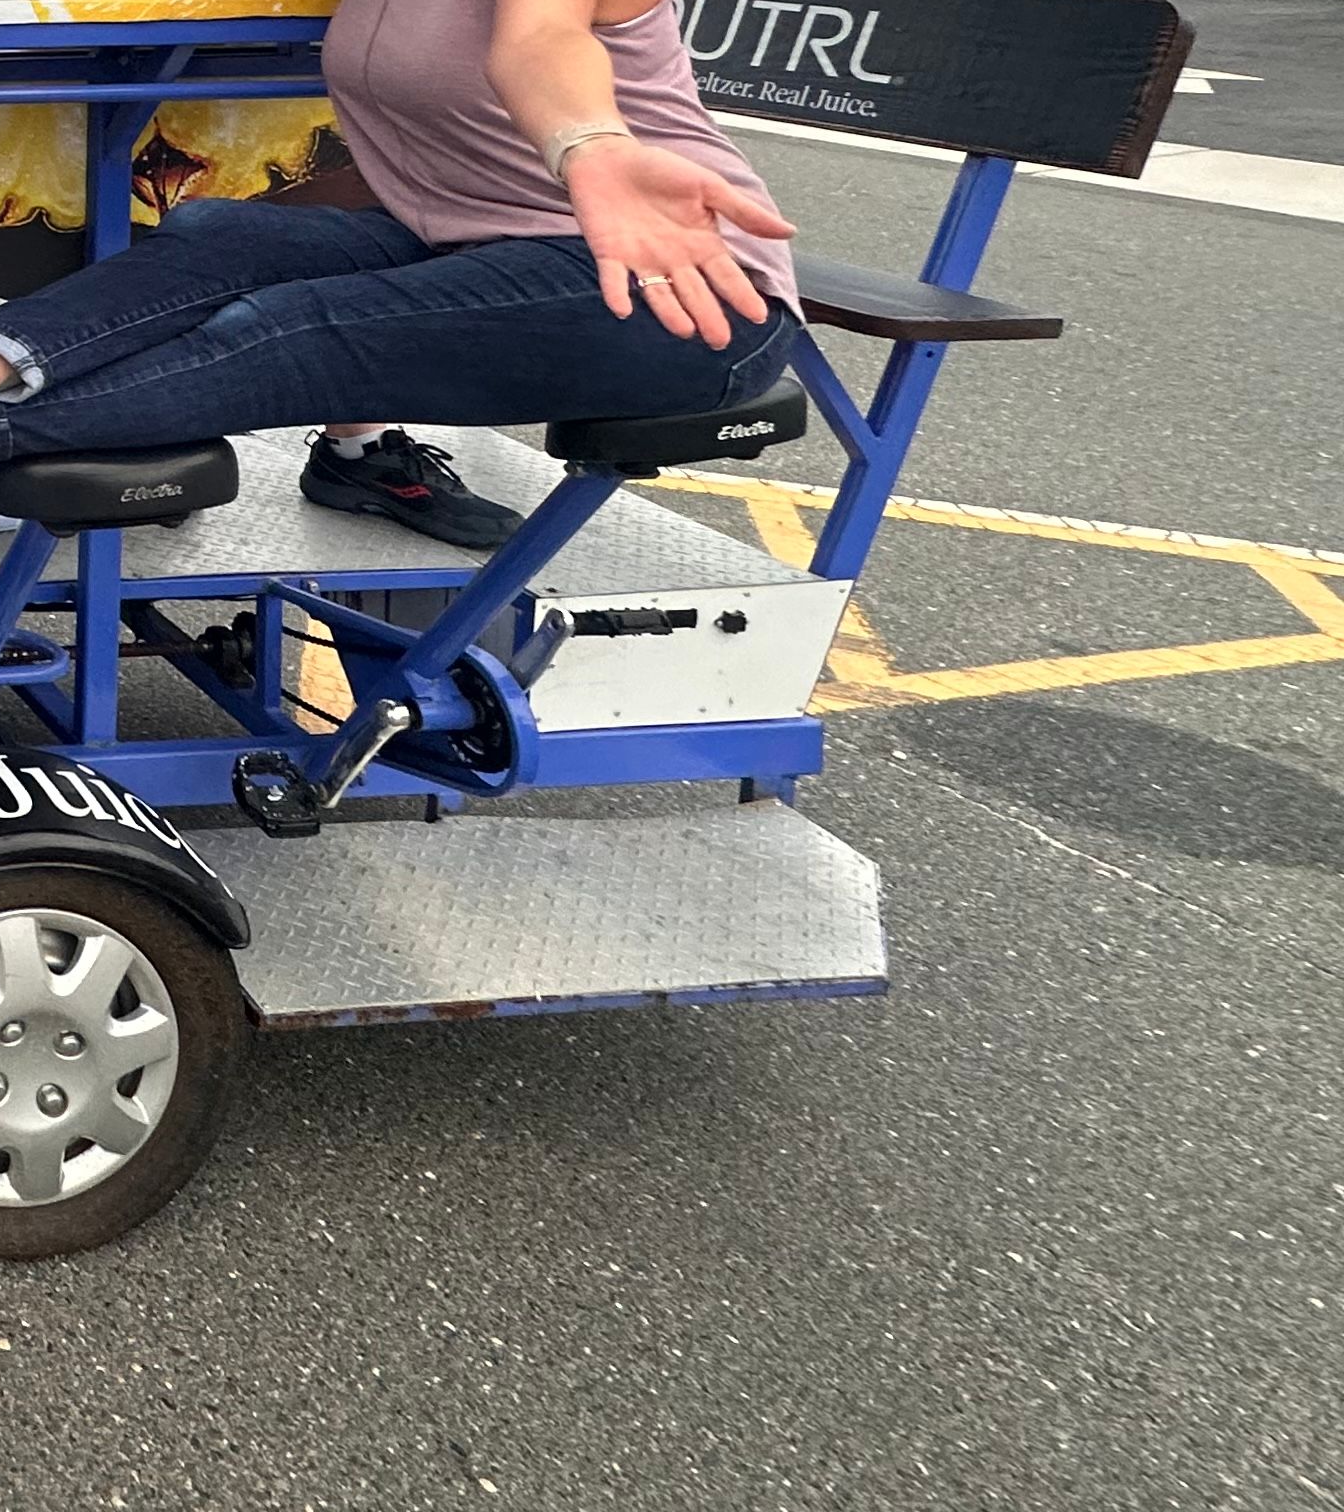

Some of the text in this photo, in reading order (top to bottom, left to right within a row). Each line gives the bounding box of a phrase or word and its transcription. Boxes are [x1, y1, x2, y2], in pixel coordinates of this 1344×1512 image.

[692, 71, 879, 118] eltzer. Real Juice.
[120, 482, 184, 503] Electra
